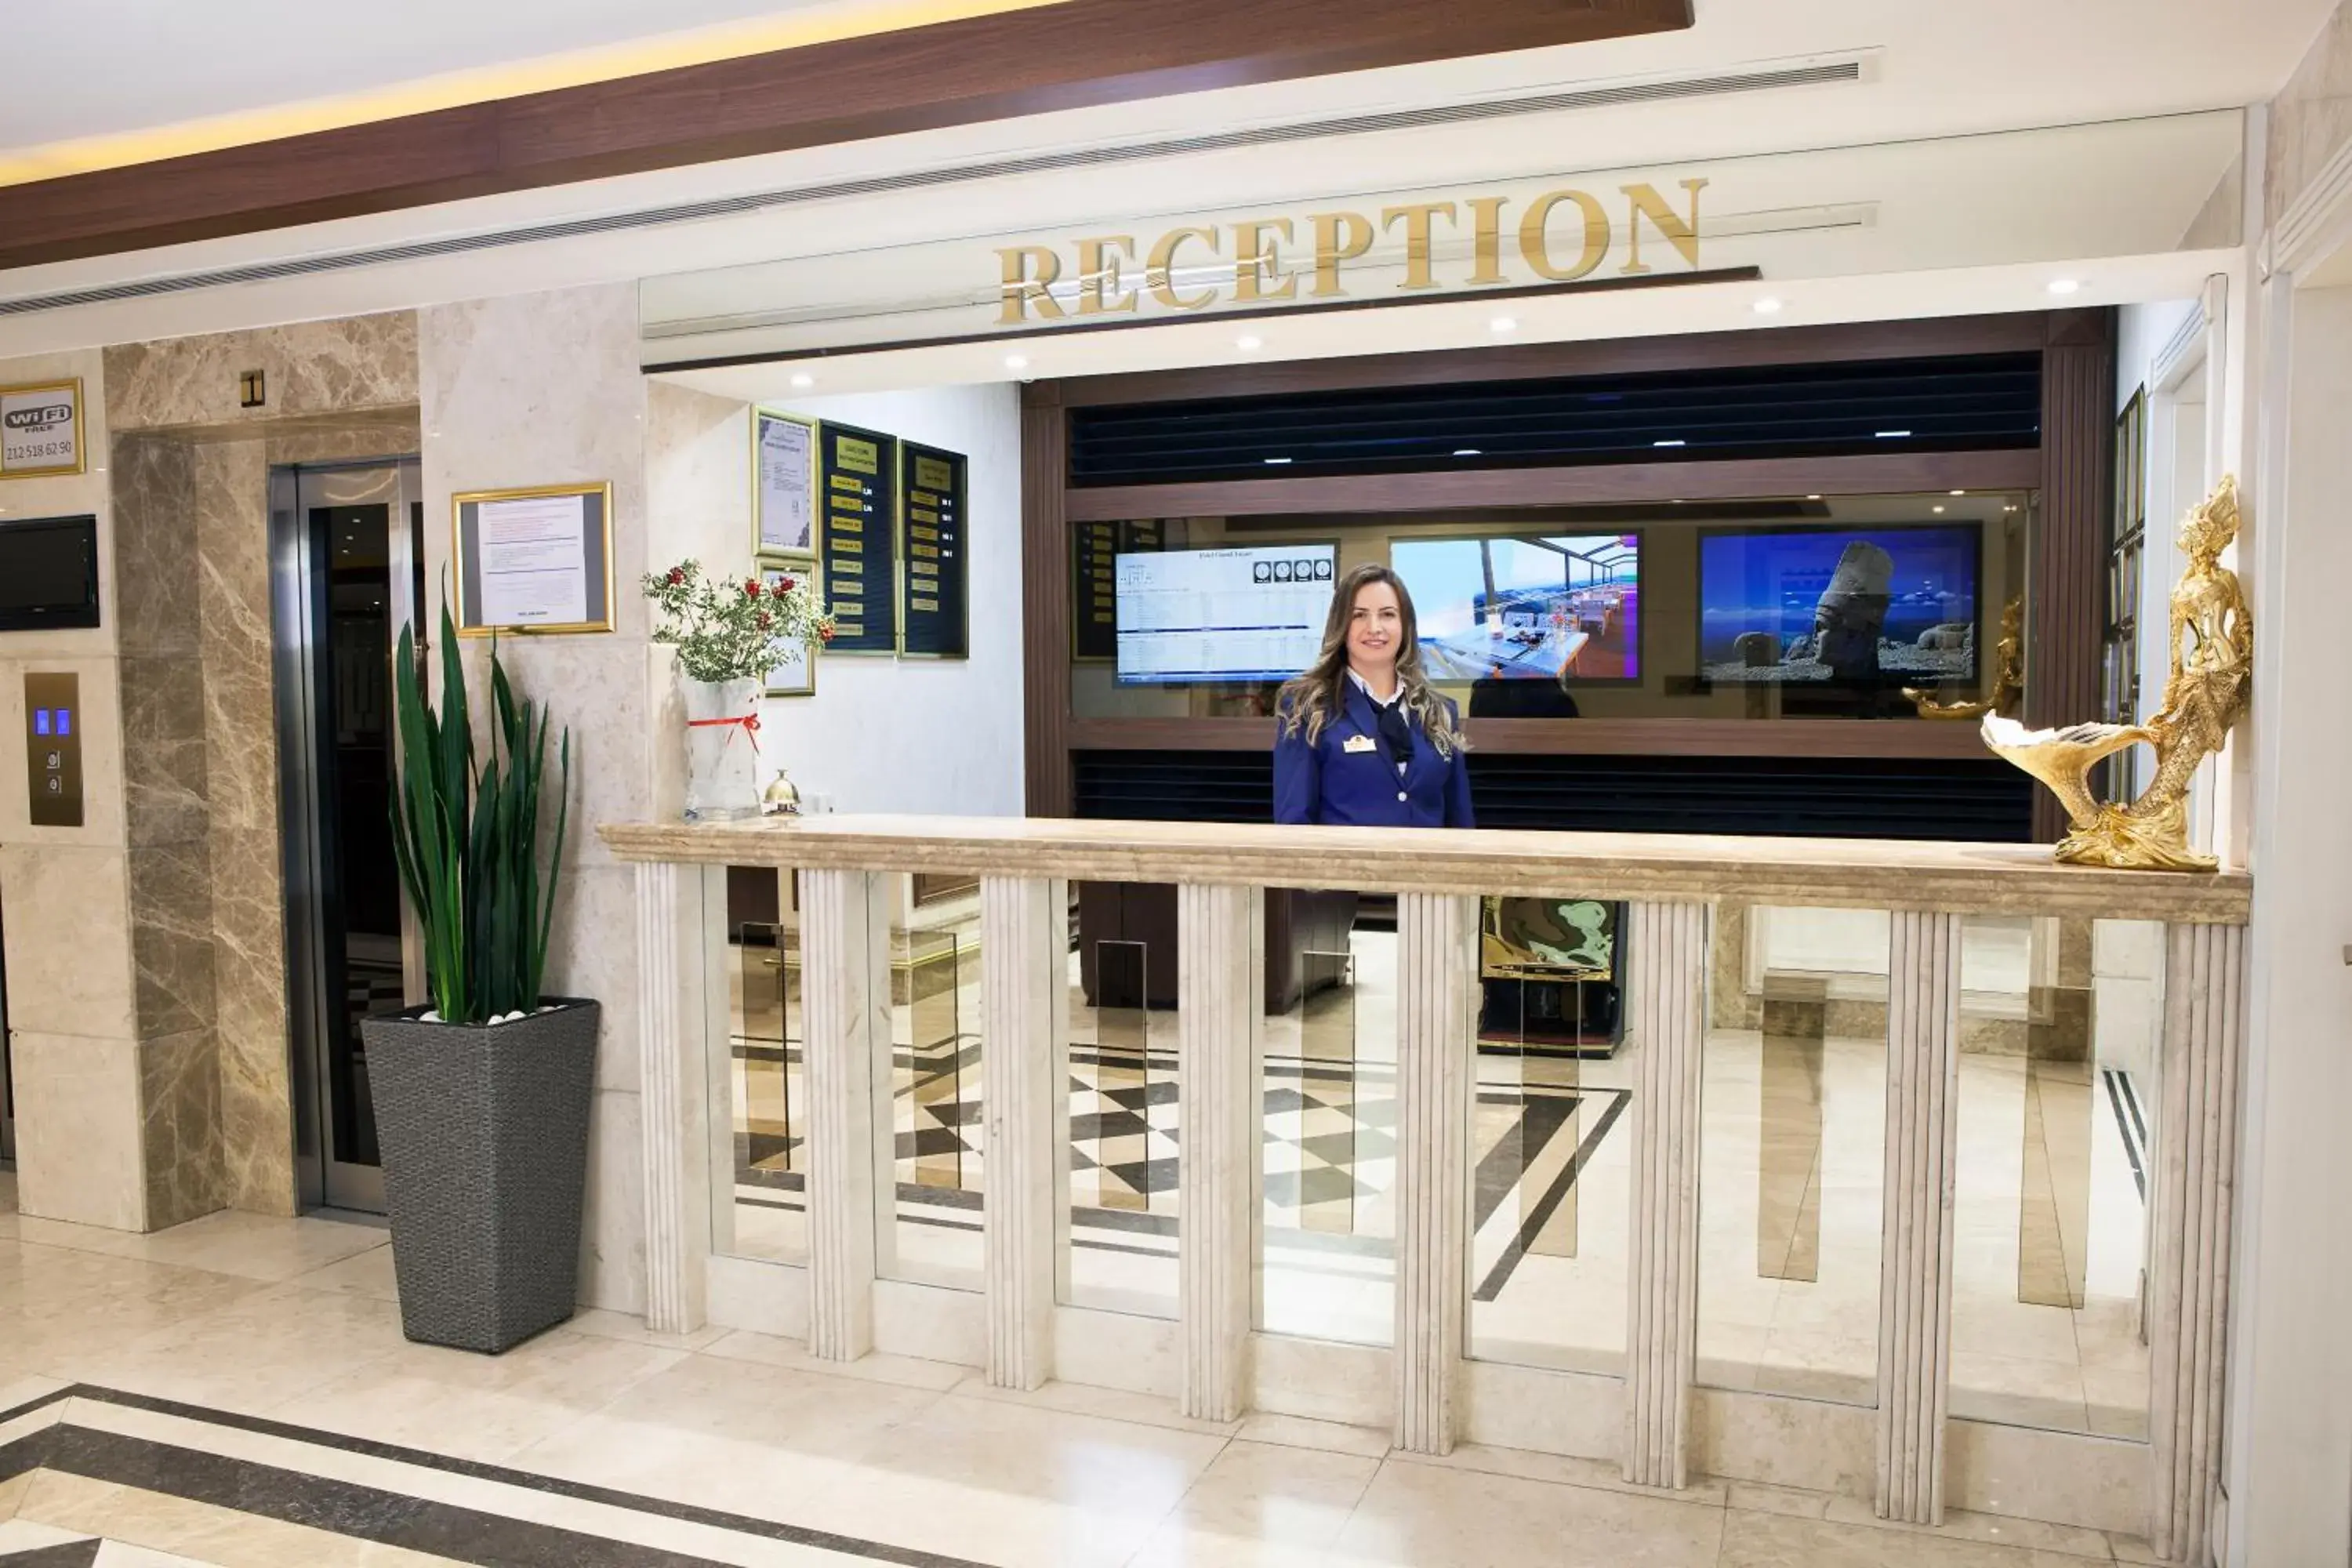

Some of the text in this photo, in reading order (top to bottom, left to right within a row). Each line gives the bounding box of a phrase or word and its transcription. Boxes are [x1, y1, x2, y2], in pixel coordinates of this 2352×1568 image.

[993, 178, 1709, 325] RECEPTION
[6, 446, 25, 460] 212
[27, 445, 44, 458] 518
